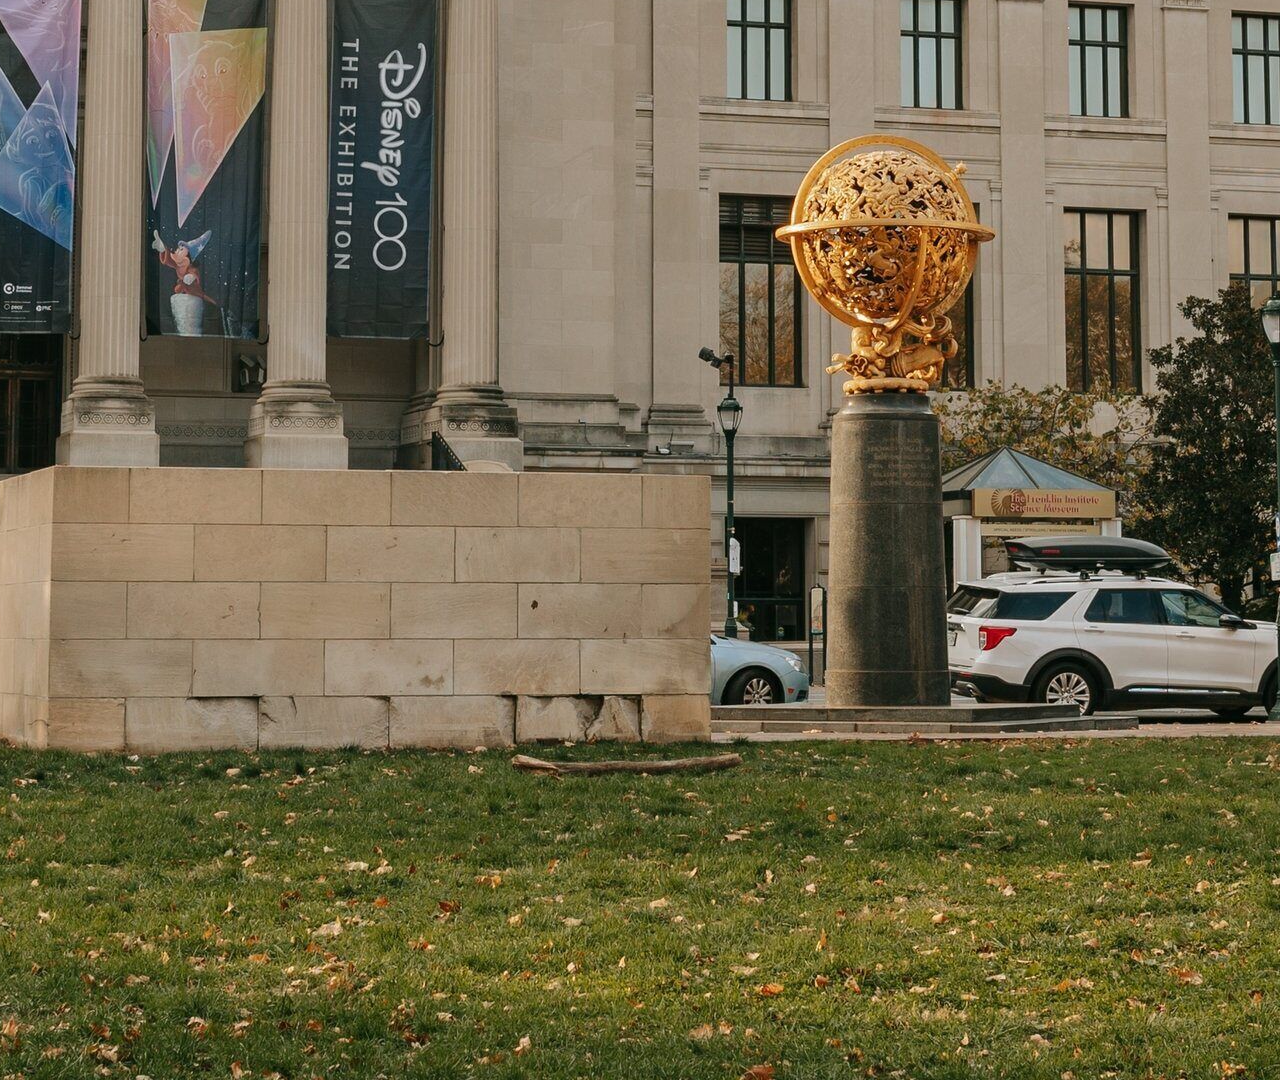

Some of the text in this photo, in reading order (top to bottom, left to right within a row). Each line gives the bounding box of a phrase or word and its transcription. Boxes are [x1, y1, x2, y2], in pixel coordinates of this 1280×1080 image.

[333, 37, 360, 270] THE EXHIBITION
[372, 192, 409, 272] 100
[1010, 504, 1079, 513] Science Museum
[1011, 493, 1100, 505] The Franklin Institute
